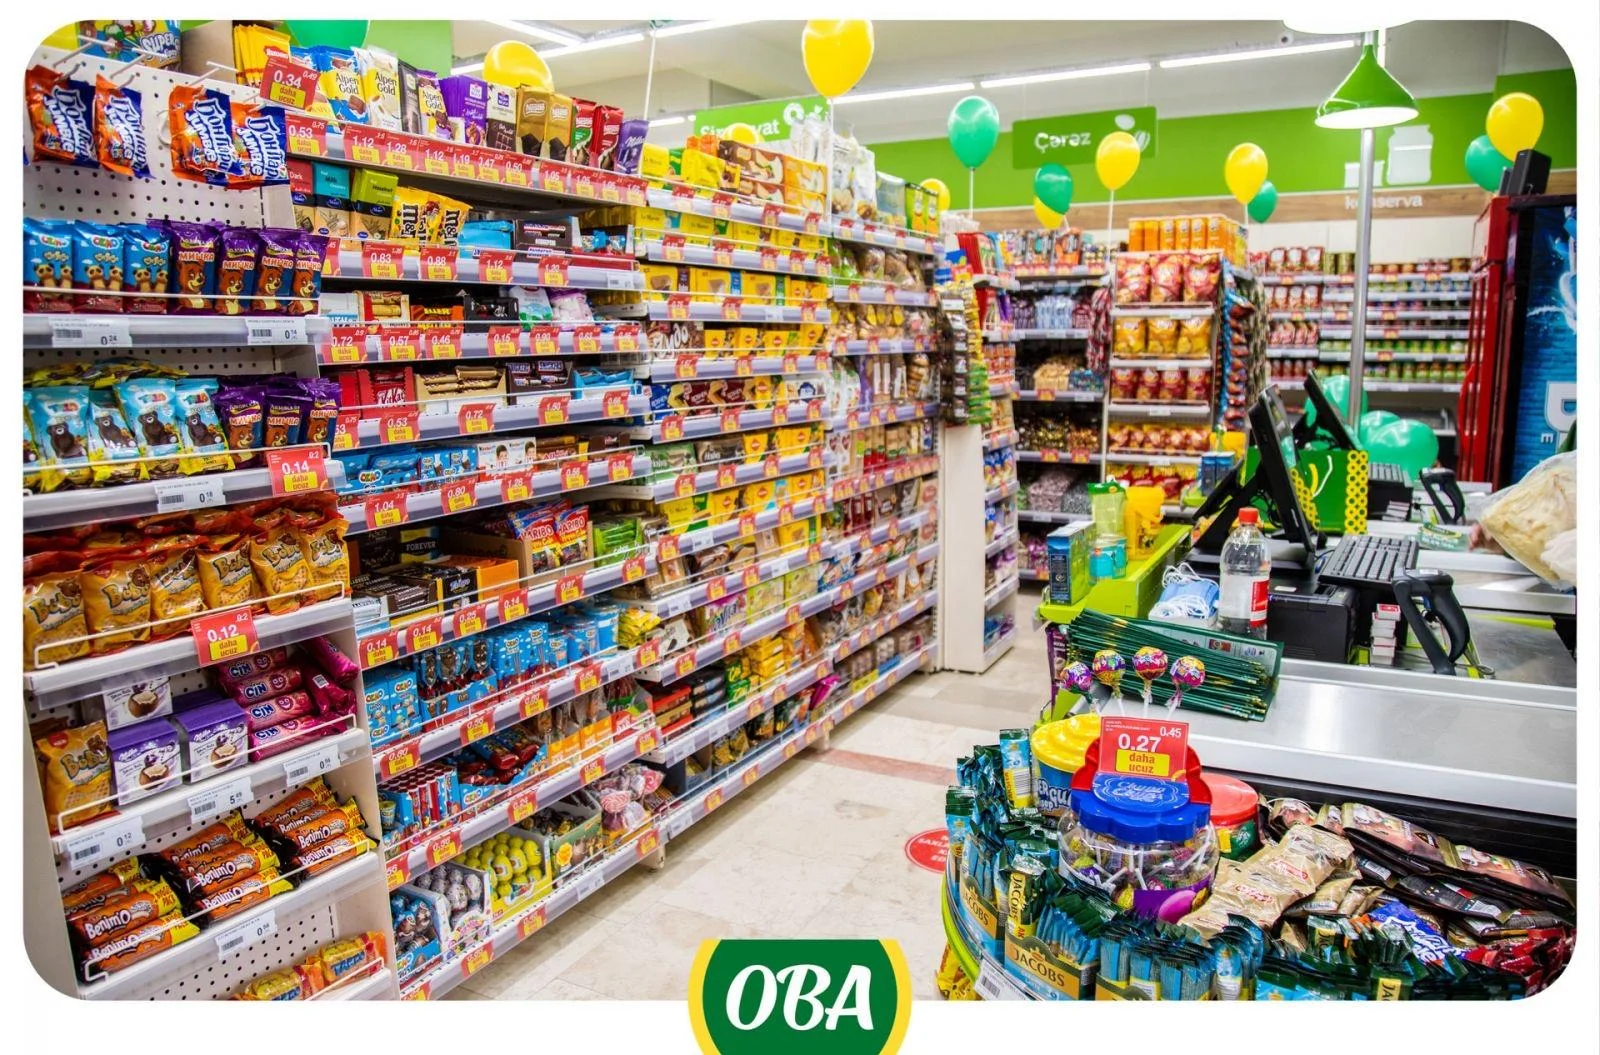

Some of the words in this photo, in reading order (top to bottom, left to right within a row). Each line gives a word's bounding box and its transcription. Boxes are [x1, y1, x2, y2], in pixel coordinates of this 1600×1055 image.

[274, 70, 302, 88] 0.34
[336, 72, 358, 87] Alpen
[375, 70, 396, 86] Alpen
[279, 87, 296, 98] daha
[339, 82, 359, 94] Gold
[377, 80, 396, 96] Gold
[278, 94, 295, 104] ucuz
[288, 125, 313, 138] 0.53
[352, 136, 374, 148] 1.12
[386, 141, 407, 154] 1.28
[1034, 132, 1091, 153] Çərəz
[425, 149, 444, 160] 1.12
[290, 172, 304, 180] Dark
[370, 253, 392, 264] 0.83
[428, 256, 446, 266] 0.88
[486, 260, 504, 270] 1.12
[389, 336, 410, 346] 0.57
[432, 336, 450, 345] 0.46
[388, 418, 408, 428] 0.53
[282, 460, 310, 474] 0.14
[448, 486, 466, 498] 0.80
[375, 502, 394, 512] 1.04
[406, 541, 436, 552] FOREVER
[504, 596, 520, 608] 0.14
[460, 611, 476, 622] 0.25
[207, 624, 239, 642] 0.12
[413, 624, 432, 636] 0.14
[220, 640, 237, 650] daha
[366, 638, 388, 652] 0.14
[220, 648, 238, 656] ucuz
[1160, 726, 1182, 738] 0.45
[1118, 734, 1162, 752] 0.27
[1129, 752, 1155, 764] daha
[1128, 764, 1154, 774] ucuz
[1010, 876, 1022, 920] JACOBS
[1012, 949, 1065, 988] JACOBS
